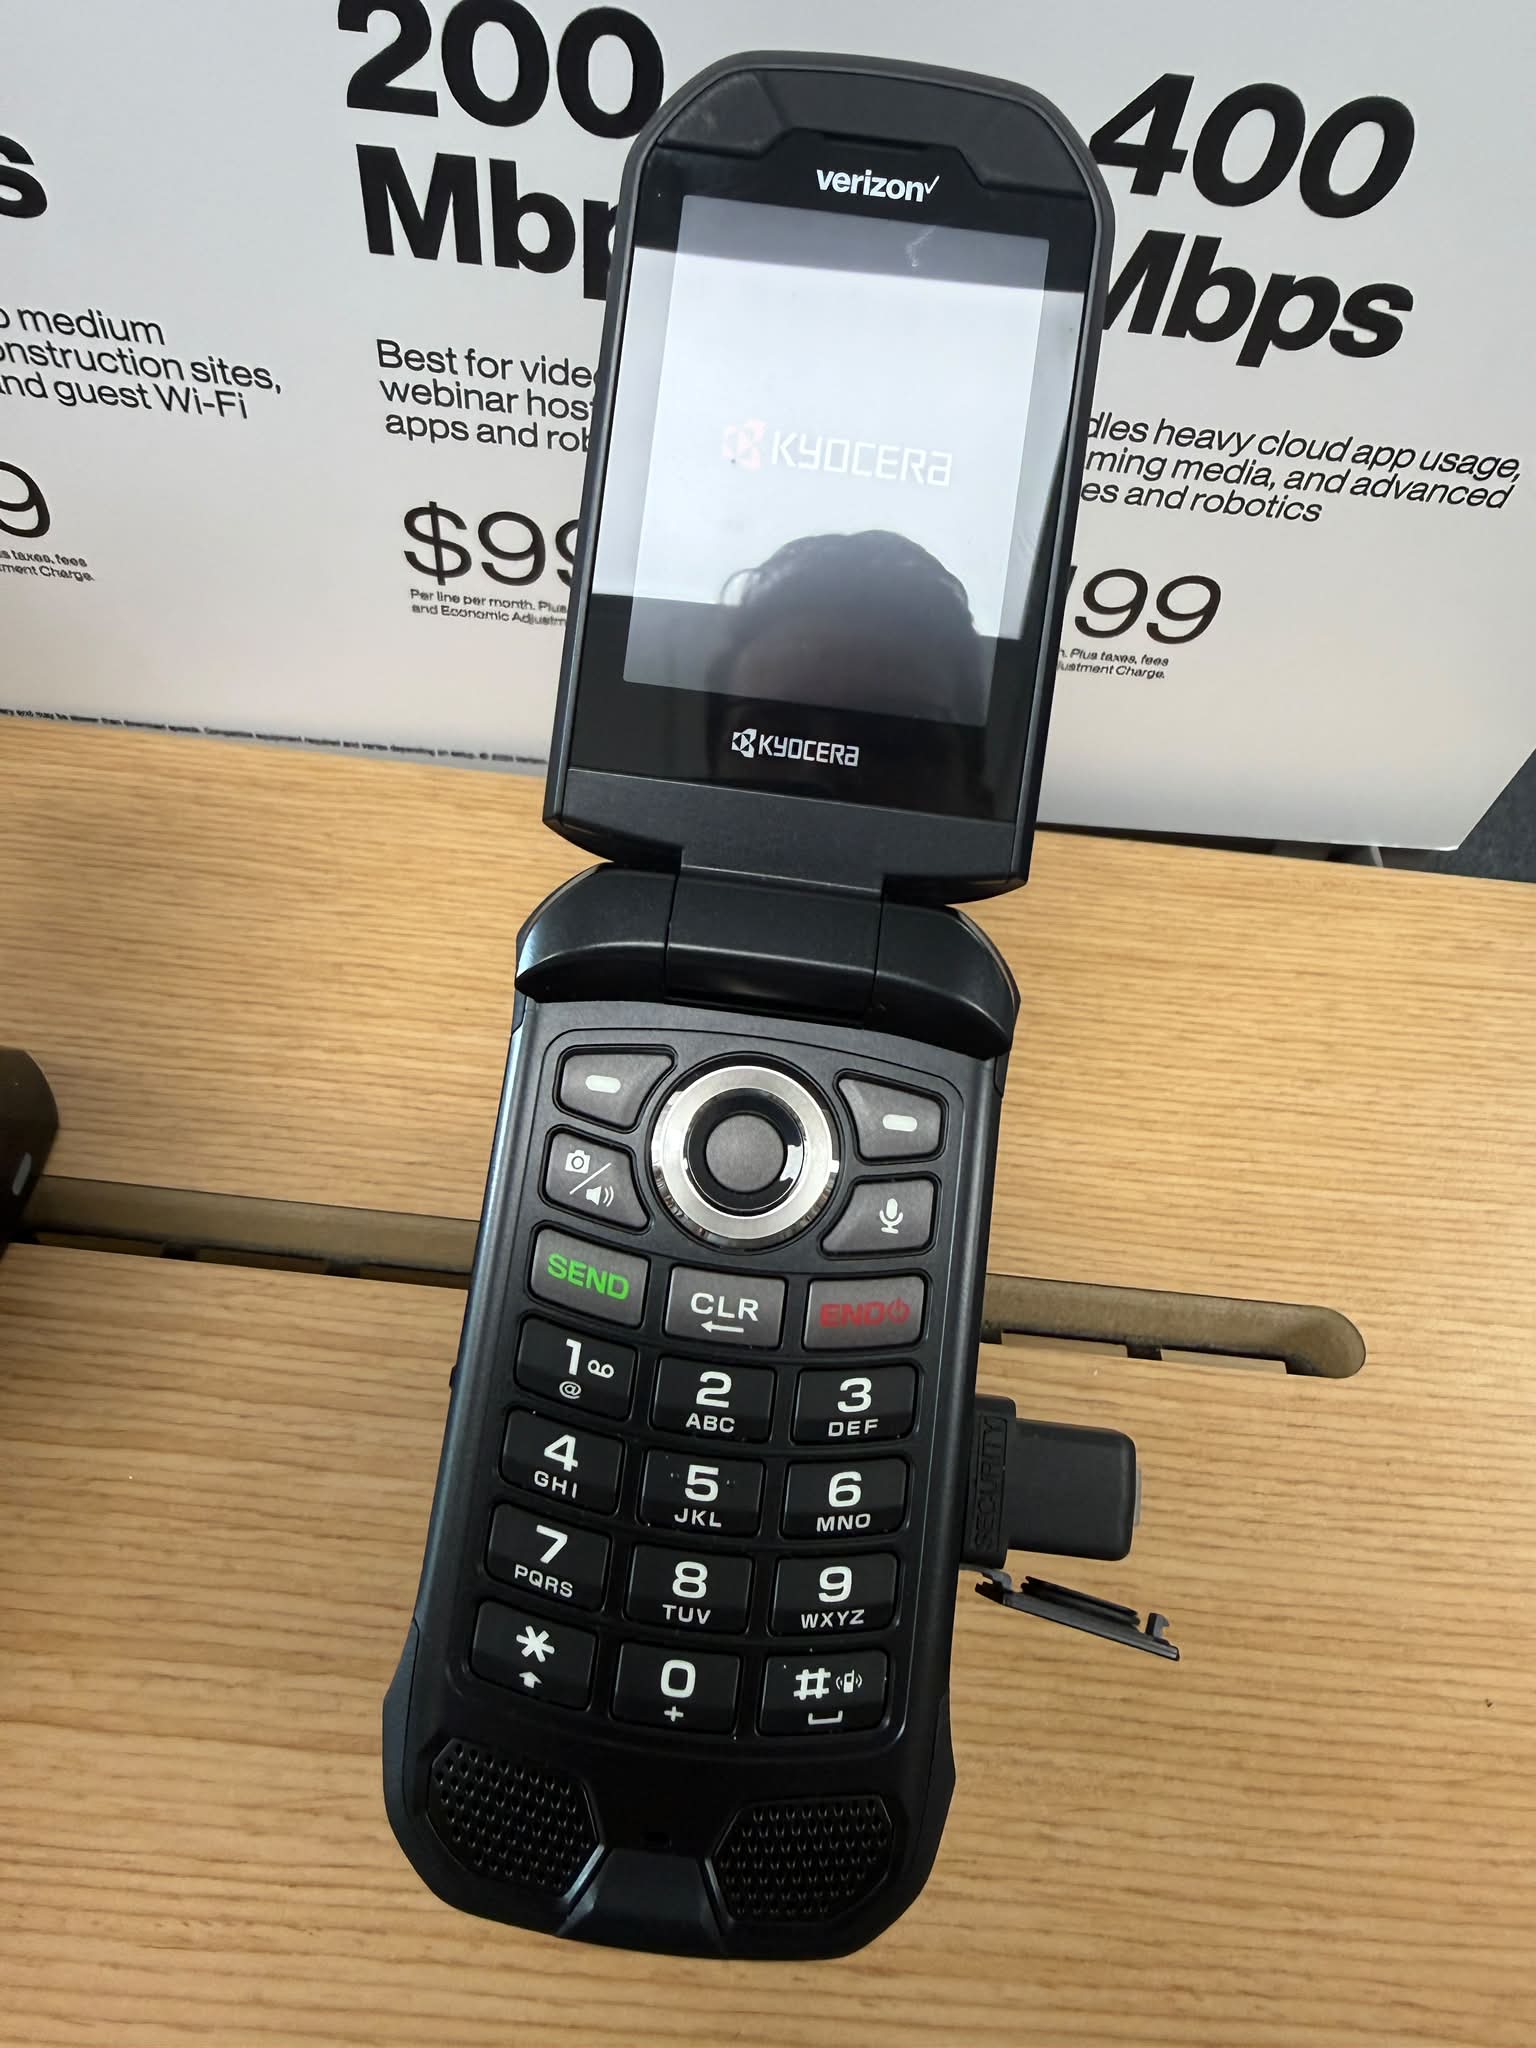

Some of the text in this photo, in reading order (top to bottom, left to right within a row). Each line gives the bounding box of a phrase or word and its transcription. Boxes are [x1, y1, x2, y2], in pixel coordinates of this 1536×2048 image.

[338, 0, 664, 139] 200
[1089, 73, 1415, 219] 400
[816, 169, 925, 202] verizon
[17, 309, 165, 346] medium
[0, 341, 281, 394] nstruction sites,
[376, 339, 600, 388] Best for vide
[0, 372, 248, 419] nd guest Wi-Fi
[379, 379, 593, 421] webinar hos
[385, 413, 470, 443] apps
[476, 422, 538, 448] and
[770, 430, 953, 488] KYOCERA
[1153, 418, 1257, 458] heavy
[1257, 430, 1353, 462] cloud
[1351, 444, 1416, 472] app
[1419, 451, 1520, 483] usage,
[1085, 447, 1515, 509] ming media, and advanced
[1081, 483, 1322, 522] es and robotics
[410, 588, 434, 601] Per
[436, 591, 460, 604] line
[463, 595, 487, 608] per
[488, 598, 535, 611] month.
[412, 605, 438, 615] and
[441, 605, 510, 622] Economic
[1070, 648, 1098, 660] Plus
[758, 734, 860, 768] KYOCERA
[547, 1252, 630, 1300] SEND
[690, 1292, 760, 1322] CLR
[819, 1302, 886, 1328] END
[565, 1338, 582, 1376] 1
[695, 1371, 732, 1408] 2
[837, 1377, 872, 1413] 3
[685, 1412, 736, 1434] ABC
[828, 1419, 878, 1437] DEF
[544, 1434, 579, 1472] 4
[533, 1470, 577, 1499] GHI
[684, 1464, 720, 1502] 5
[828, 1471, 862, 1508] 6
[674, 1509, 722, 1528] JKL
[816, 1513, 870, 1532] MNO
[536, 1524, 568, 1564] 7
[514, 1564, 573, 1598] PQRS
[672, 1560, 709, 1599] 8
[818, 1565, 852, 1603] 9
[662, 1603, 711, 1625] TUV
[801, 1609, 865, 1629] WXYZ
[660, 1659, 696, 1699] 0
